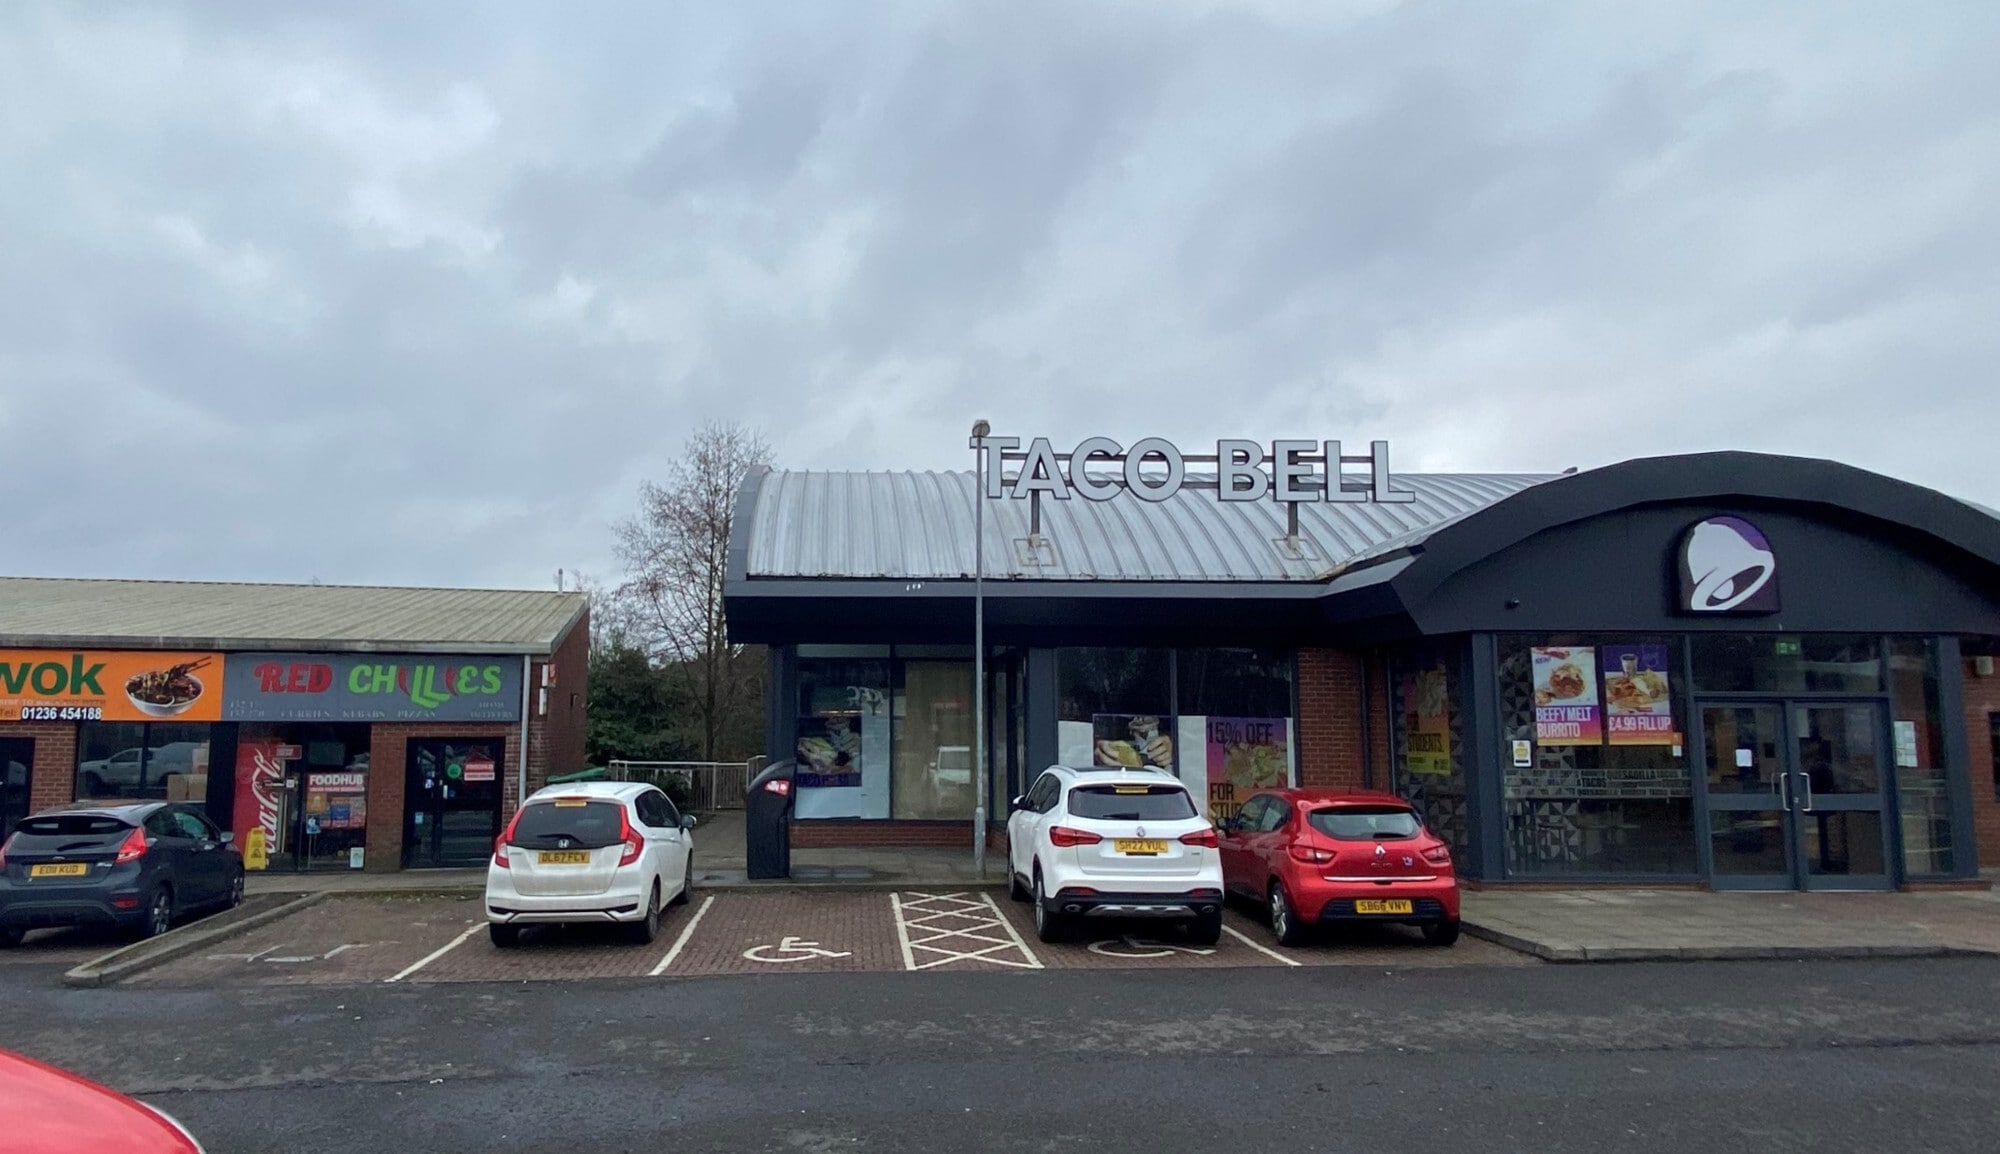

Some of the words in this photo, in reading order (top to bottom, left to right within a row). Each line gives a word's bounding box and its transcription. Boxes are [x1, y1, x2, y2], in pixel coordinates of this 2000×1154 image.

[969, 436, 1185, 503] TACO
[1216, 439, 1416, 504] BELL
[253, 661, 333, 694] RED
[21, 707, 57, 720] 01236
[59, 707, 102, 720] 454188
[1536, 707, 1567, 722] BEEFY
[1567, 707, 1592, 721] MELT
[1537, 722, 1581, 738] BURRITO
[1608, 716, 1637, 731] £4.99
[1638, 717, 1657, 731] FILL
[1657, 717, 1671, 731] UP
[1207, 722, 1241, 745] 15%
[1245, 723, 1274, 745] OFF
[309, 774, 364, 786] FOODHUB
[1210, 783, 1235, 800] FOR
[541, 852, 564, 863] DL67
[567, 852, 587, 862] FCV
[1361, 901, 1387, 911] SB66
[1388, 901, 1407, 910] VNY
